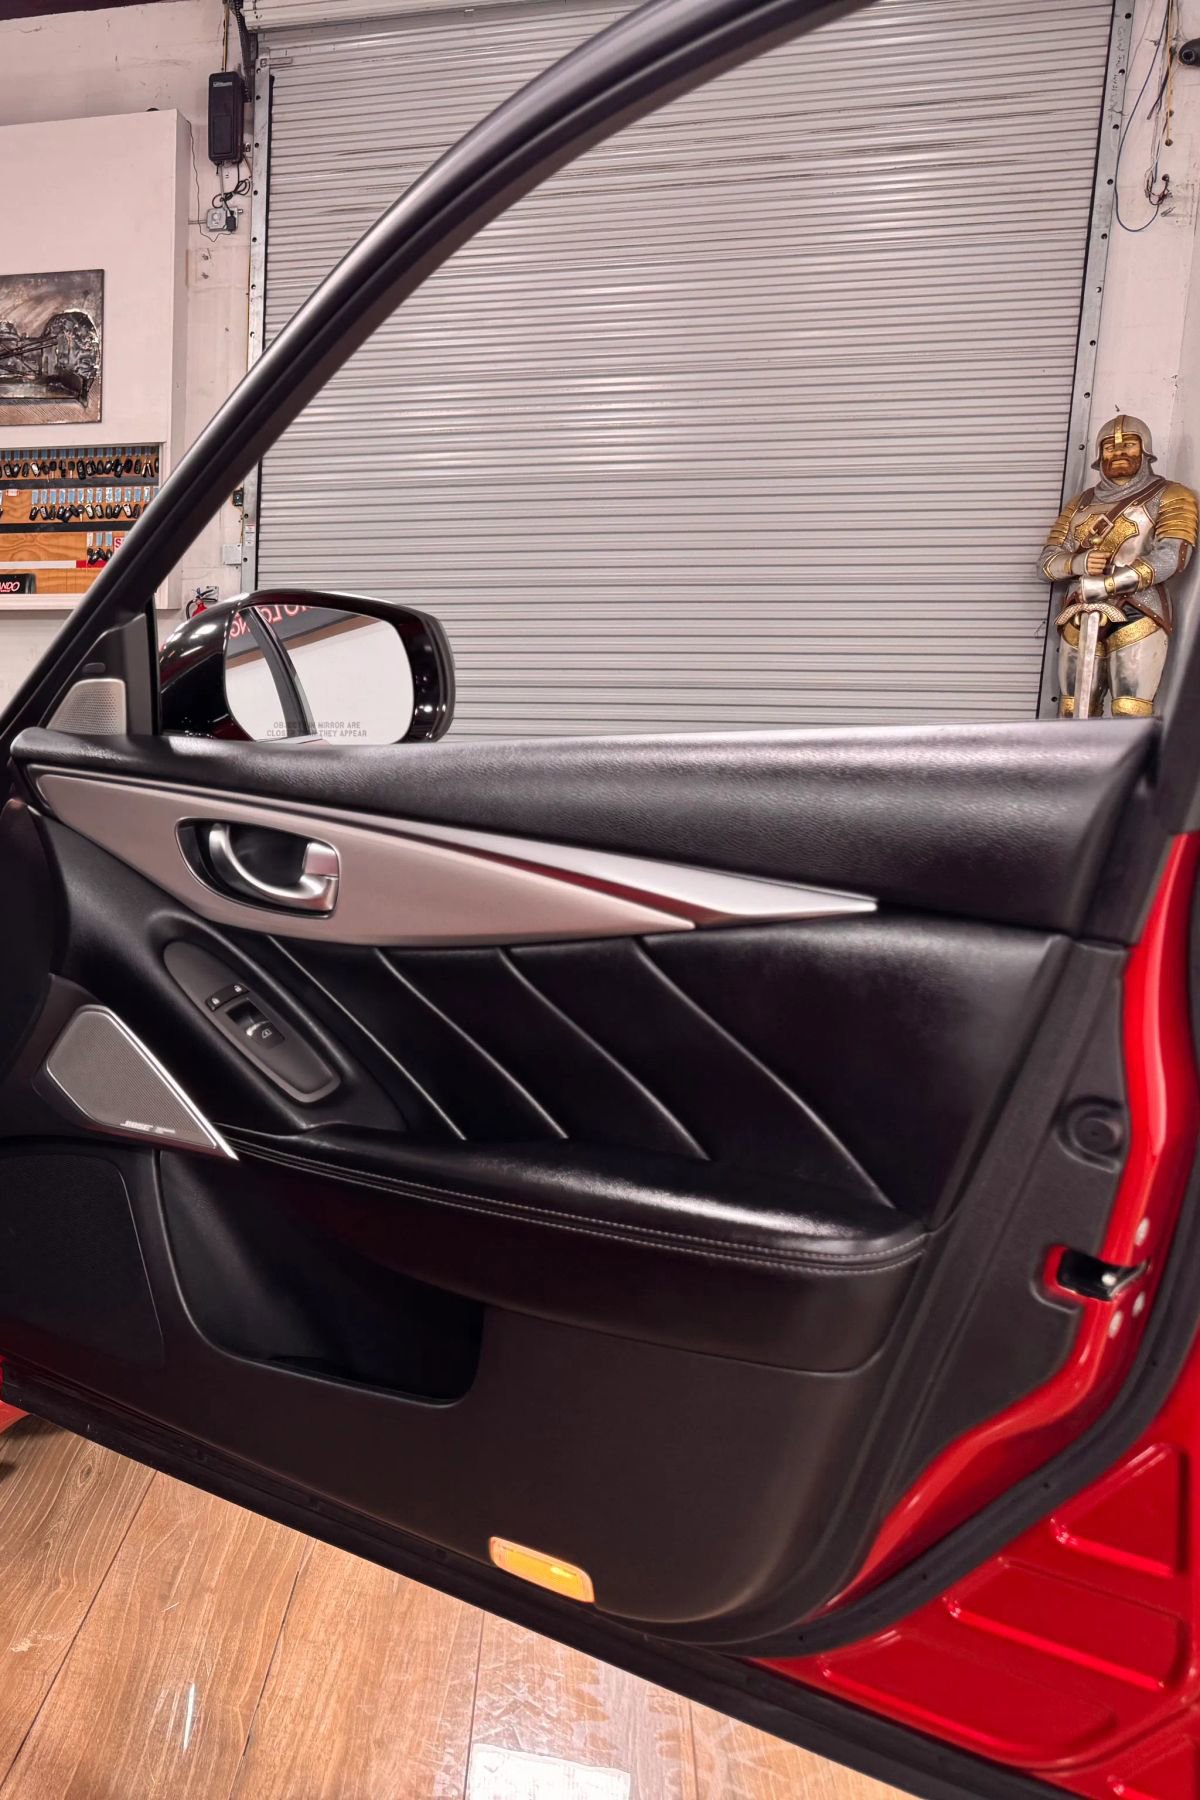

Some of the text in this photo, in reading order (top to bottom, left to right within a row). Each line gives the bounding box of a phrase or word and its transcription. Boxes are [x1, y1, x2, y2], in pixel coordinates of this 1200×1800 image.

[318, 721, 345, 729] MIRROR
[347, 721, 361, 729] ARE
[319, 729, 337, 737] THEY
[339, 729, 368, 737] APPEAR
